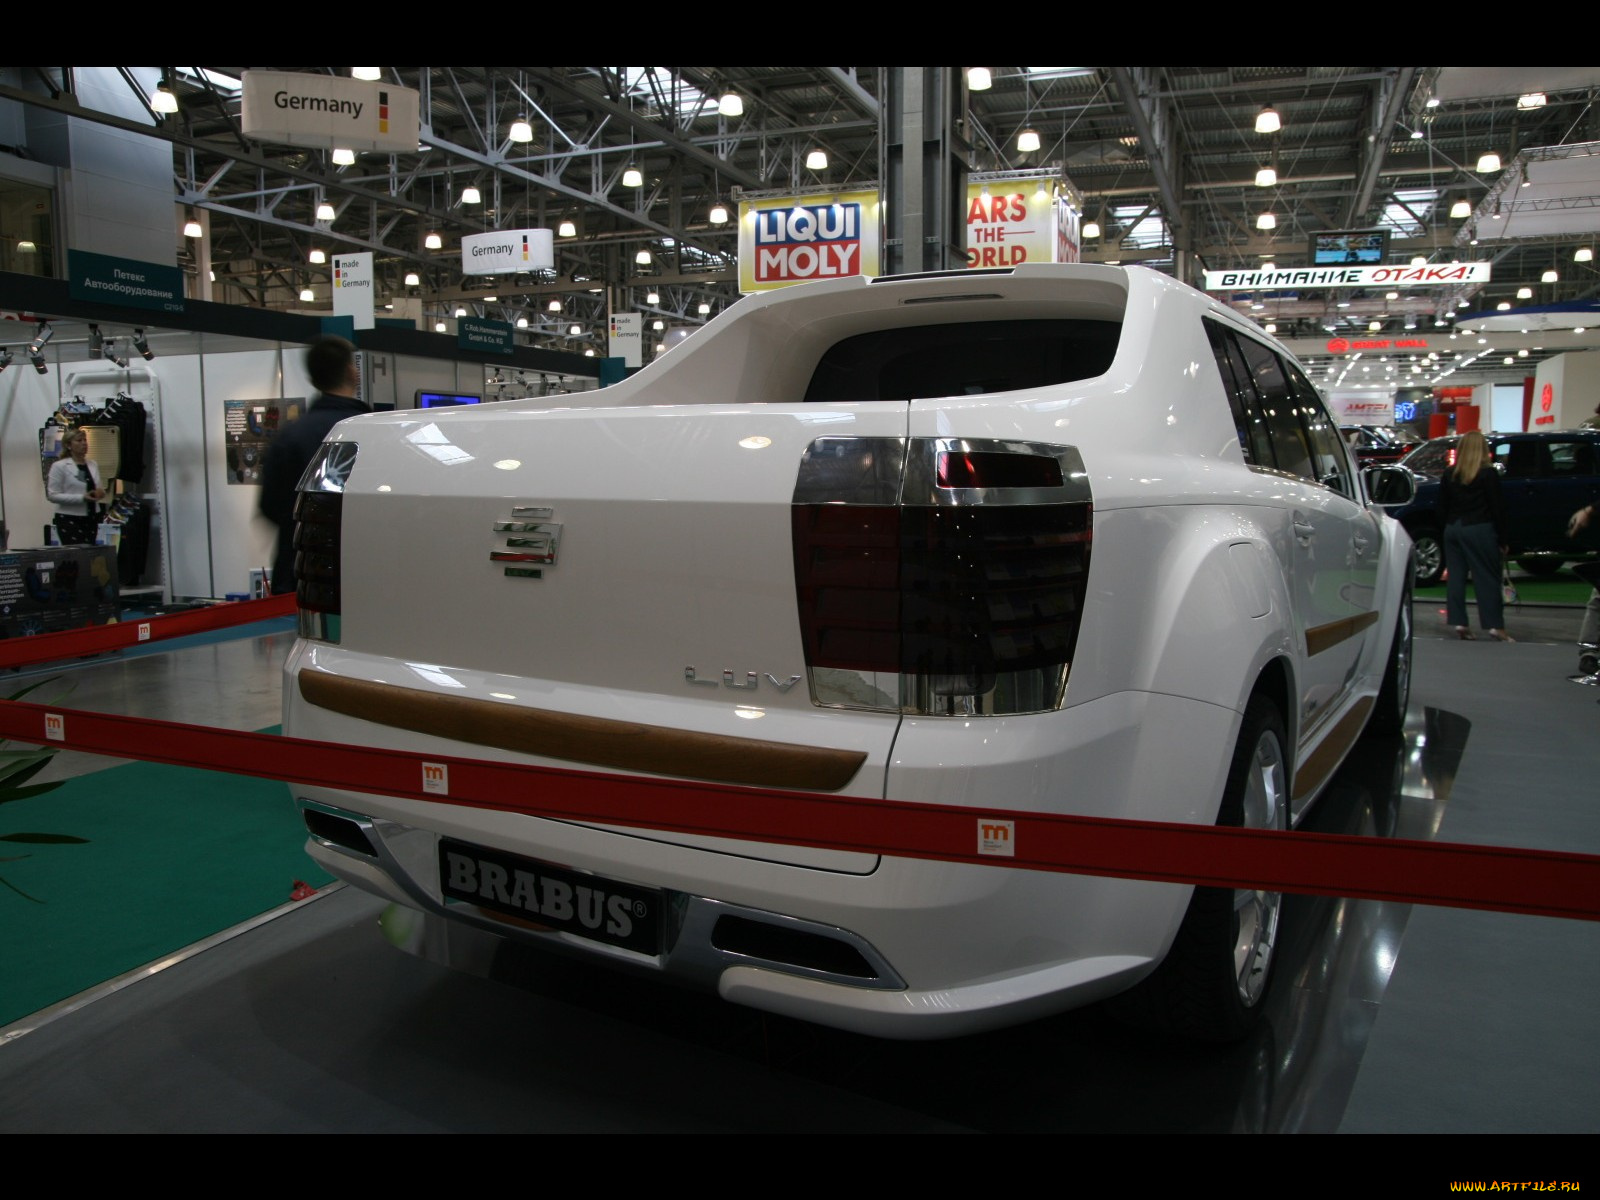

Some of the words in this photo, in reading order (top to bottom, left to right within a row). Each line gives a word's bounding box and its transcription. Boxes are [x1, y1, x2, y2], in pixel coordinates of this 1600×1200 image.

[273, 91, 364, 119] Germany
[967, 193, 1027, 224] ARS
[760, 206, 855, 242] LIQUI
[974, 227, 1005, 243] THE
[472, 242, 514, 257] Germany
[760, 243, 858, 278] MOLY
[967, 245, 1027, 268] ORLD
[113, 268, 145, 282] Петекс
[341, 260, 359, 268] made
[342, 279, 371, 288] Germany
[1220, 270, 1363, 286] ВНИМАНИЕ
[1371, 266, 1475, 282] ОТАКА!
[84, 277, 173, 299] Автооборудование
[684, 665, 802, 694] LUV
